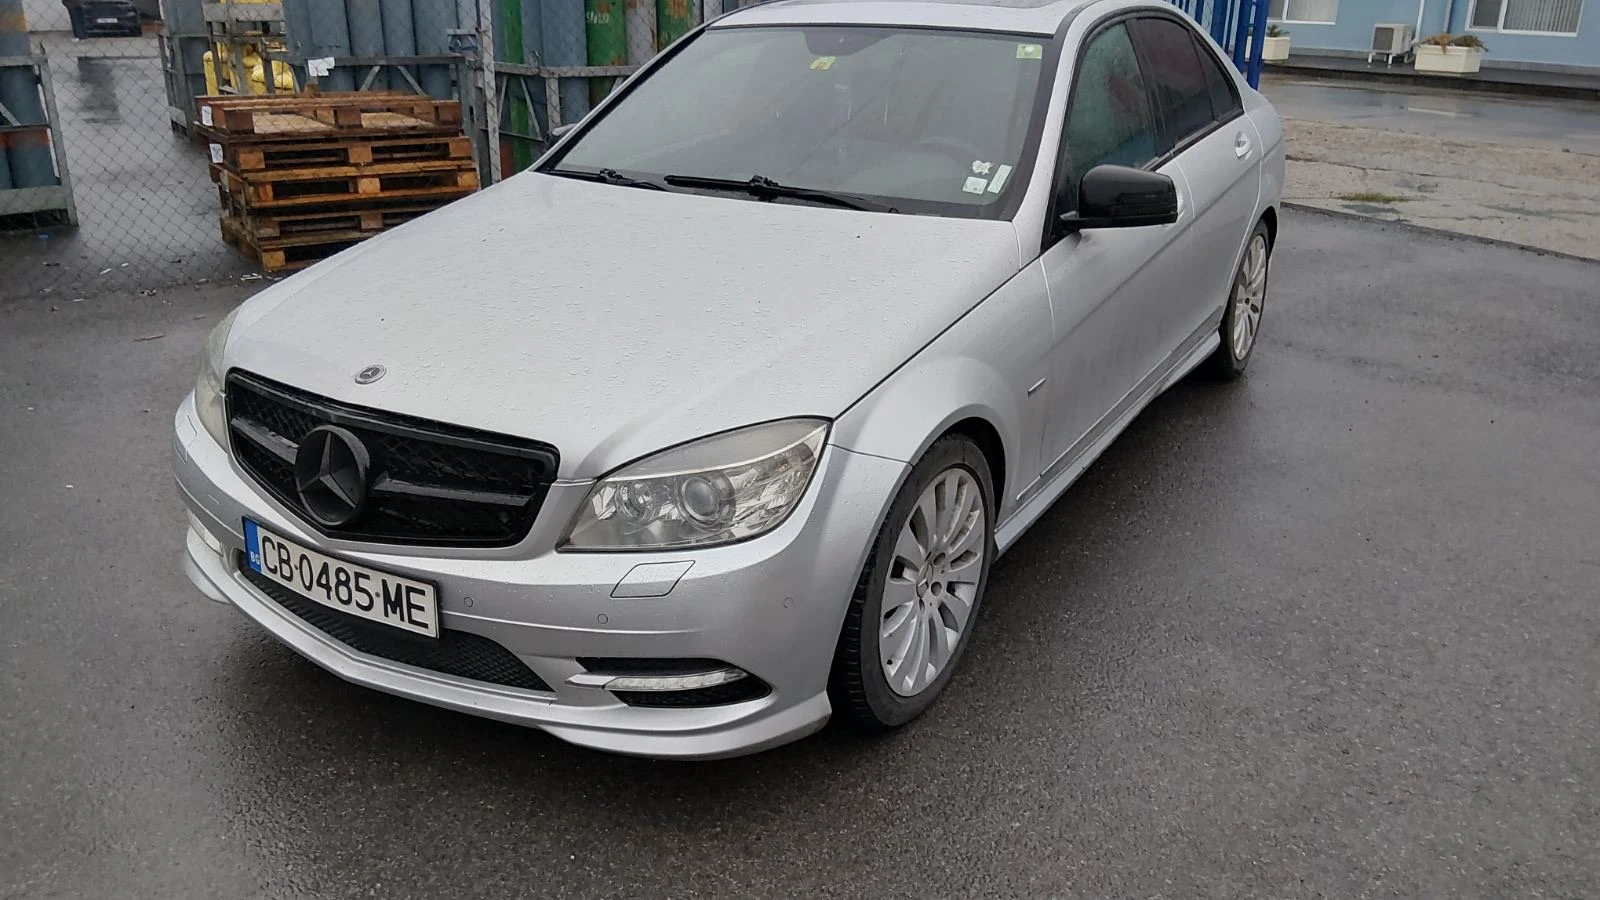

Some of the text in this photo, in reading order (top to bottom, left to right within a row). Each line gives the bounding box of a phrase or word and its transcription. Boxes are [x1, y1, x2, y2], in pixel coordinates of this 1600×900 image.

[250, 551, 261, 565] BG
[261, 535, 429, 629] CB 0485 ME
